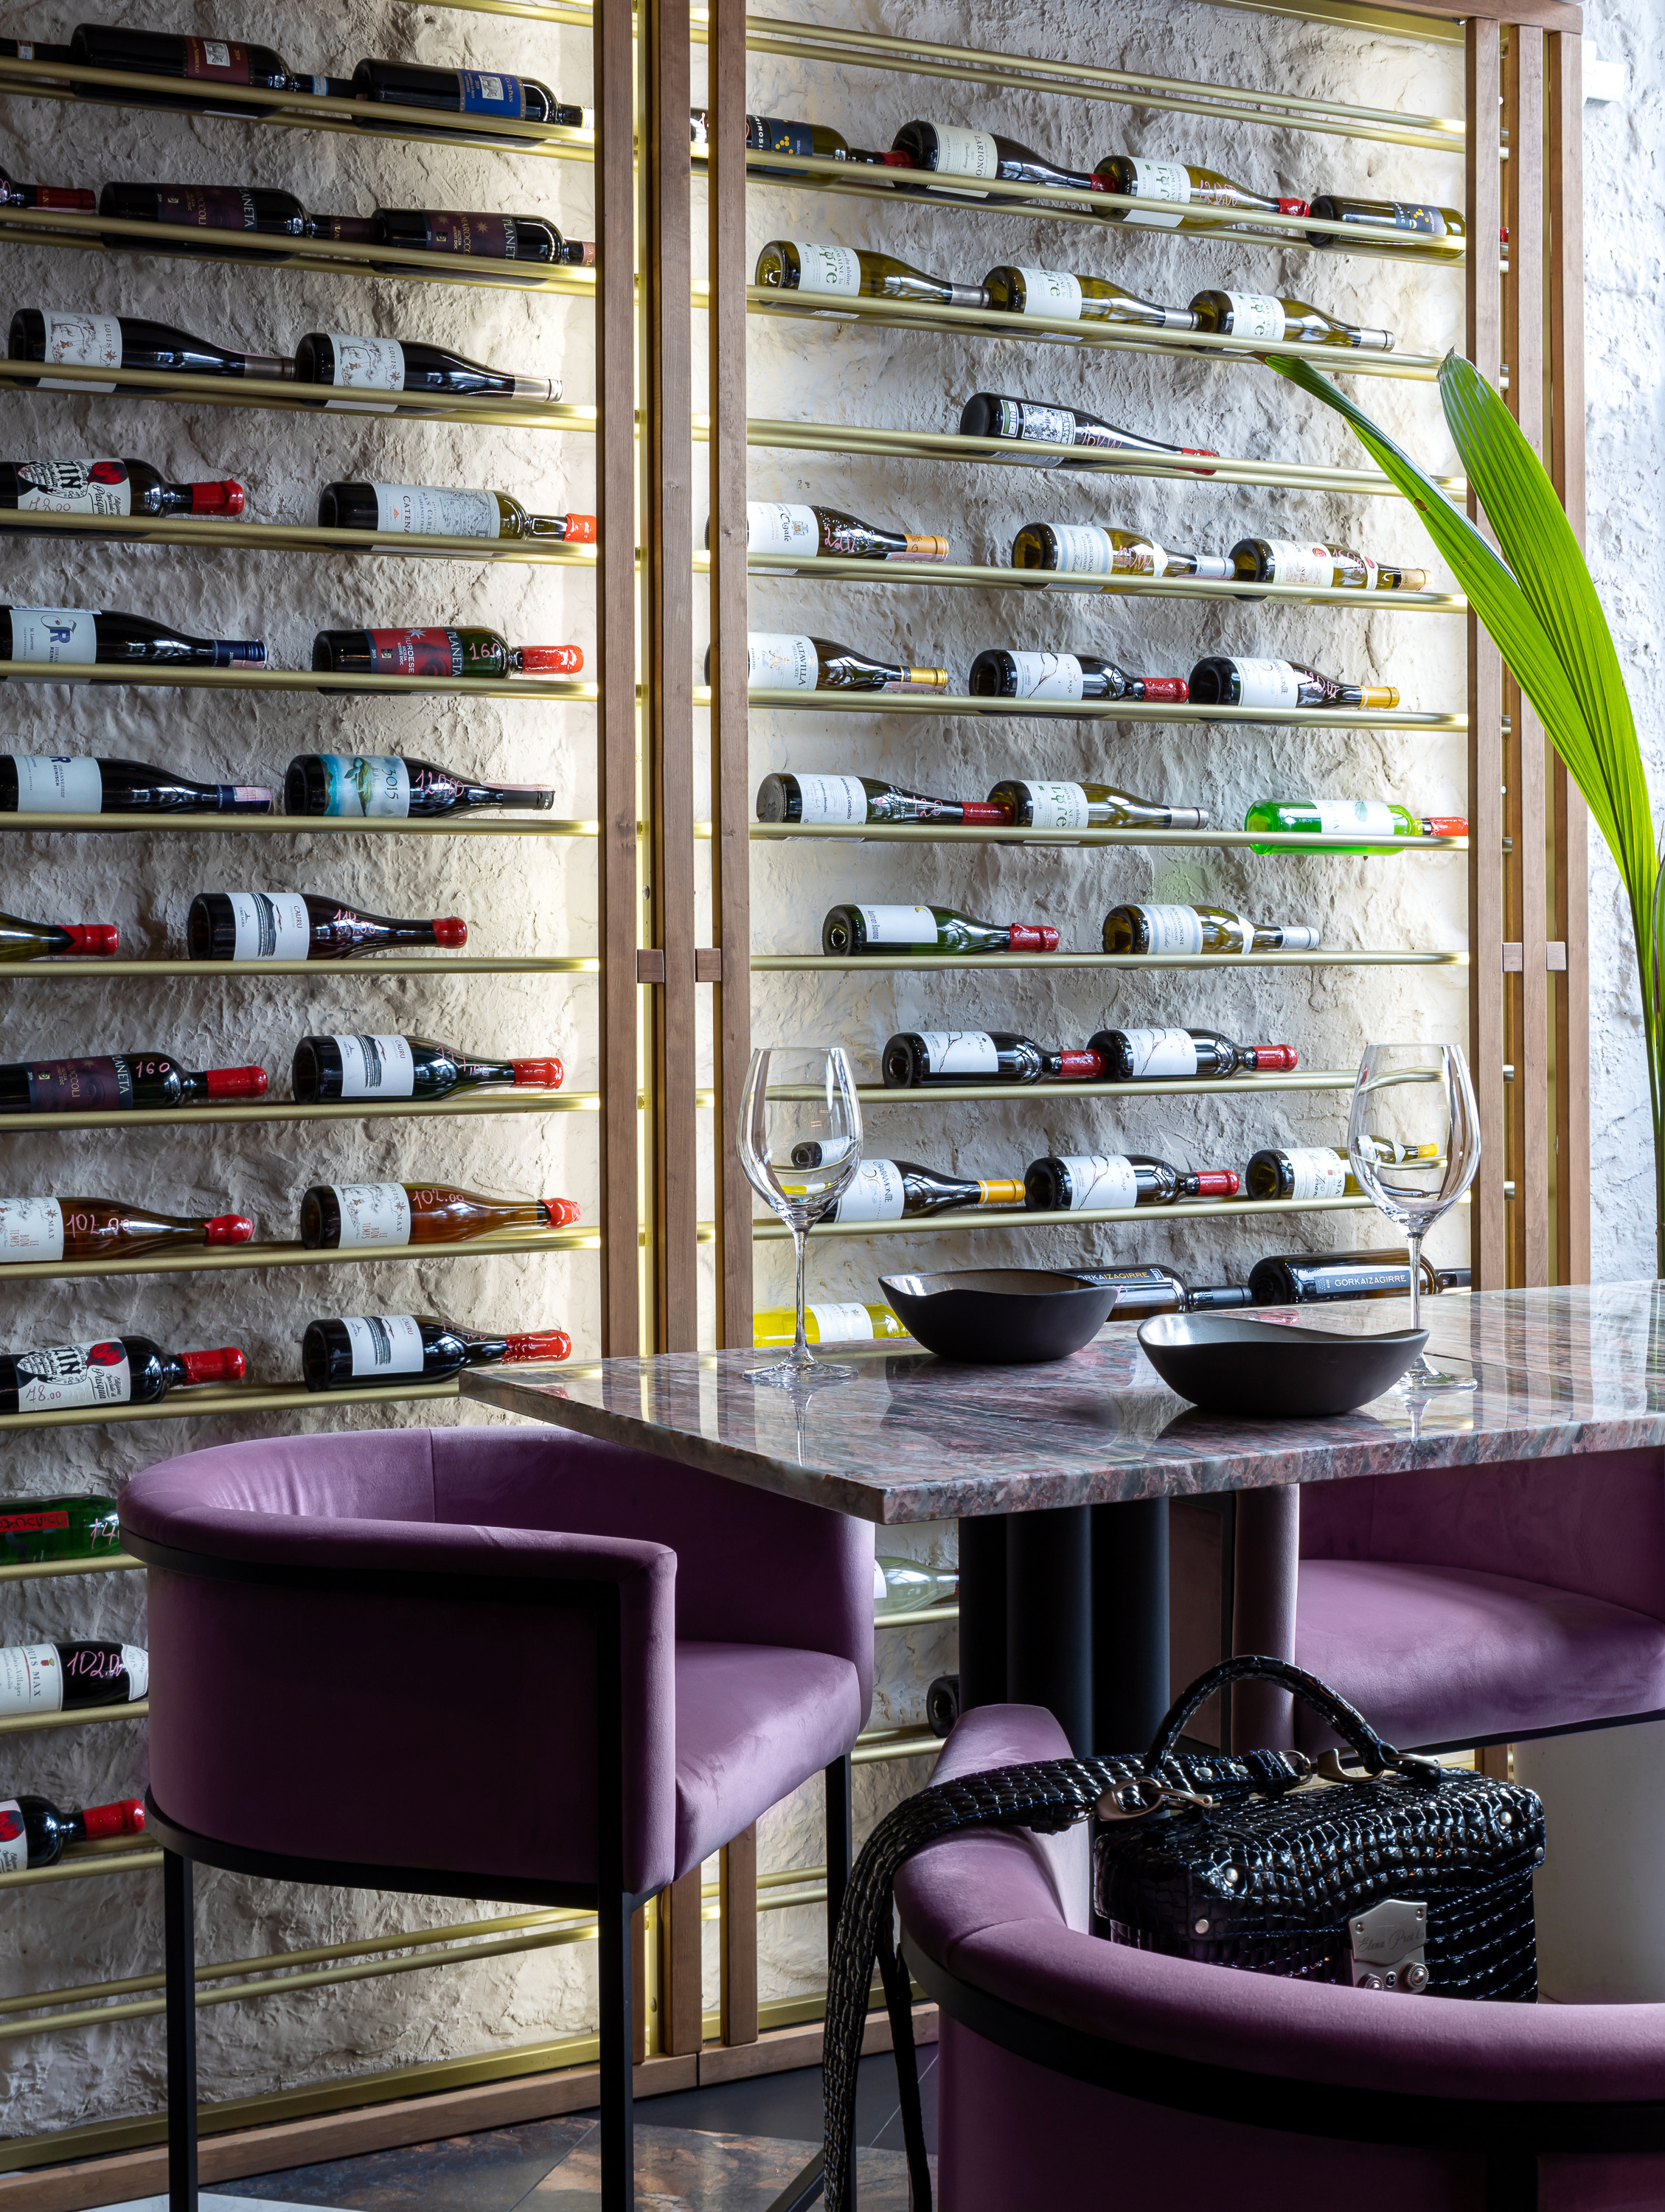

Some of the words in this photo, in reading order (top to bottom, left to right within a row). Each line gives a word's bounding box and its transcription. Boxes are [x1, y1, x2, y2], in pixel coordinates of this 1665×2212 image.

[751, 115, 764, 151] PRIMOSI
[974, 135, 985, 177] LARIONO
[501, 219, 515, 260] PLANET
[104, 323, 113, 349] LOUIS
[388, 345, 397, 370] LOUIS
[91, 484, 106, 515] Pasqu
[780, 513, 792, 543] Cigale
[1085, 534, 1095, 573] BOURGOGN
[403, 635, 415, 674] BURDESE
[446, 632, 463, 677] PLANETA
[470, 643, 501, 661] 160
[793, 640, 807, 686] ALTAVILLA
[380, 768, 400, 801] 3015
[846, 796, 854, 820] Contacto
[1050, 786, 1068, 827] Lyre
[293, 905, 304, 928] CAURU
[1170, 908, 1185, 946] BOURGOGNE
[872, 924, 881, 939] Banana
[394, 1040, 406, 1060] CAURU
[136, 1062, 170, 1078] 160
[413, 1188, 465, 1209] 102.00
[1334, 1180, 1343, 1198] MA
[10, 1229, 20, 1248] TEMPS
[20, 1234, 29, 1247] BON
[361, 1222, 372, 1239] TEMPS
[370, 1228, 380, 1239] BON
[1077, 1272, 1150, 1281] ORKAIZAGIRRE
[1334, 1274, 1408, 1287] GORKAIZAGIRRE
[401, 1318, 414, 1335] CAURU
[25, 1385, 61, 1403] 78.00
[91, 1368, 108, 1399] Pasqua
[90, 1517, 120, 1550] 14
[24, 1645, 38, 1667] OUIS
[32, 1671, 41, 1697] MAX
[1358, 1935, 1386, 1952] Elena
